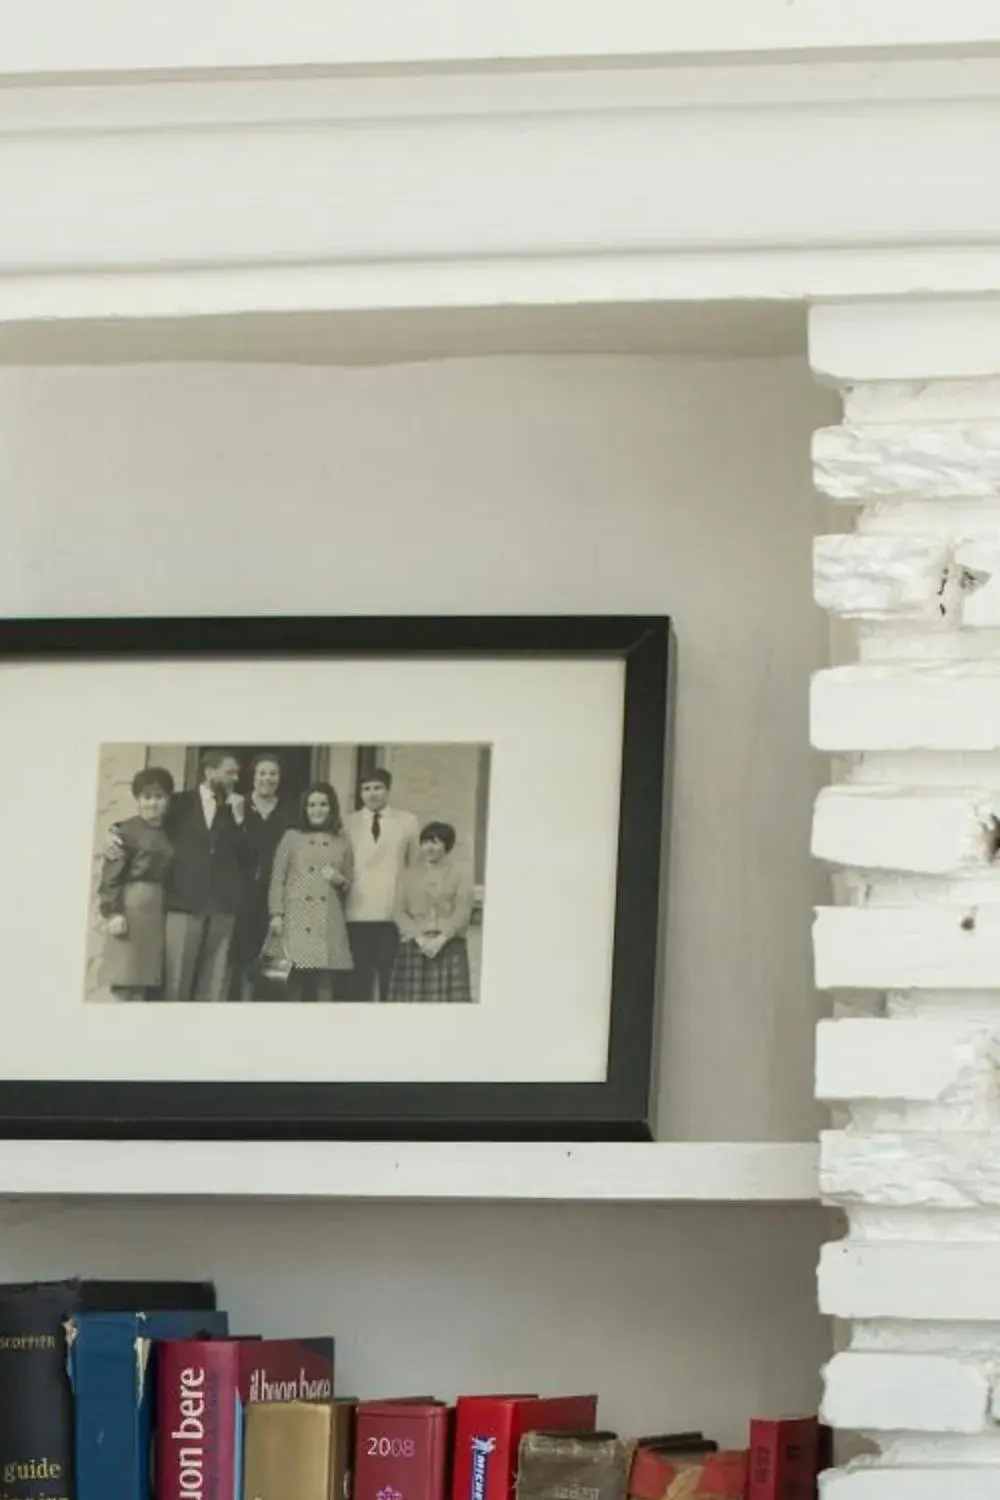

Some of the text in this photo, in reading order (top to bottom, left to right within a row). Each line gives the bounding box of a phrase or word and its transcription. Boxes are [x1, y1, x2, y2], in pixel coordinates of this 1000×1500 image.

[171, 1366, 205, 1440] bere
[366, 1436, 416, 1458] 2008
[3, 1456, 63, 1483] guide
